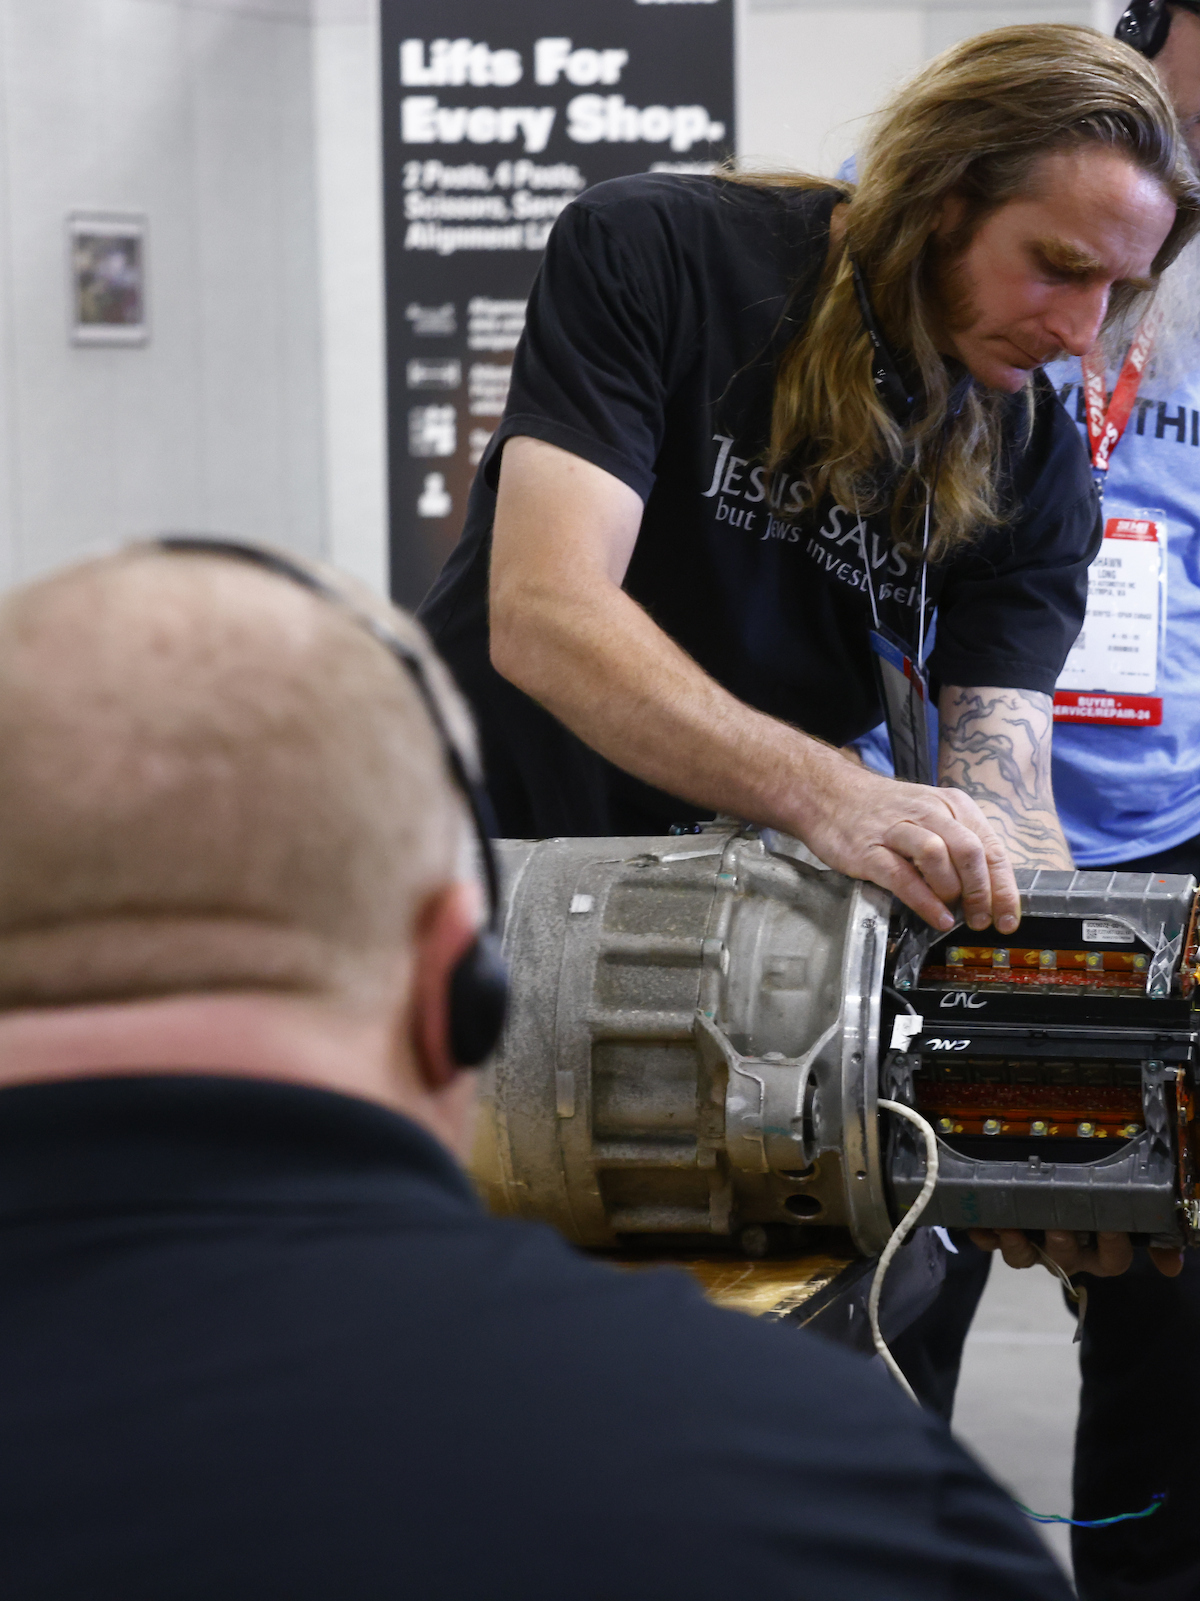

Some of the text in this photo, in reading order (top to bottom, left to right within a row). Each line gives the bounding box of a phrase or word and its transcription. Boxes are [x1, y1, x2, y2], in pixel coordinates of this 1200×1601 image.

[401, 37, 628, 87] Lifts For
[401, 94, 725, 153] Every Shop.
[715, 496, 757, 531] but
[1053, 704, 1151, 720] ERVICE/REPAIR-24
[1078, 696, 1115, 708] BUYER
